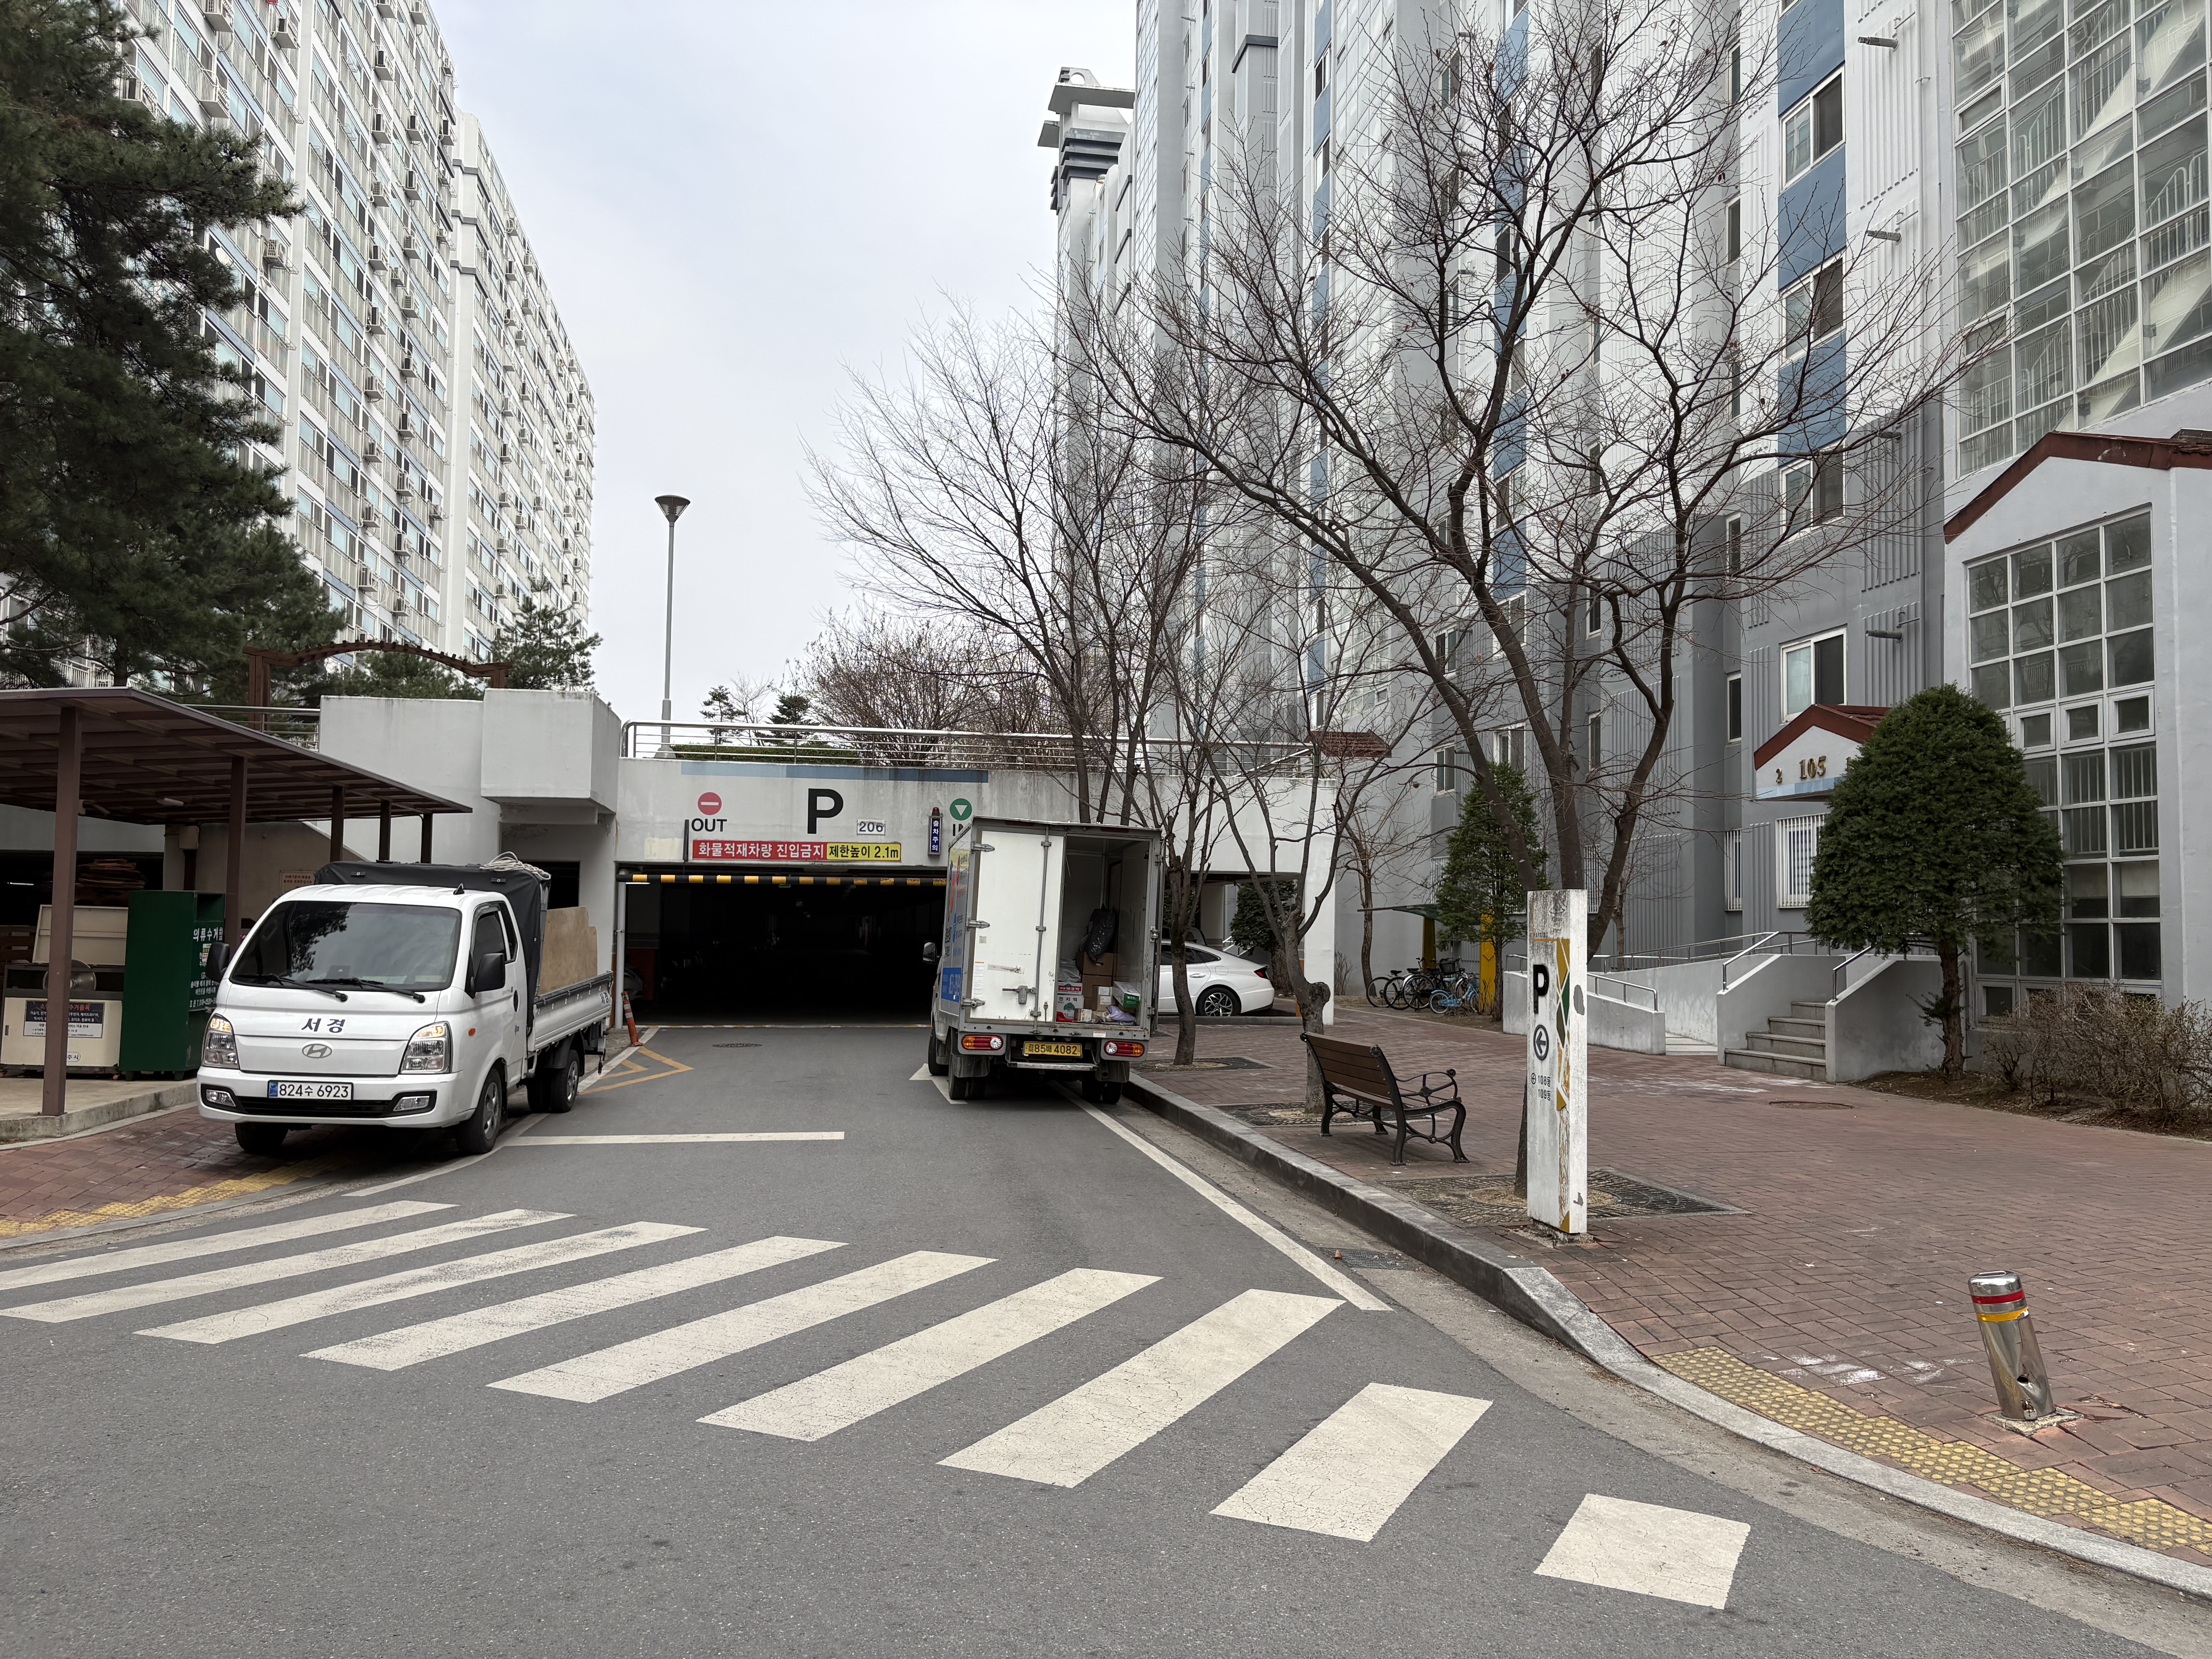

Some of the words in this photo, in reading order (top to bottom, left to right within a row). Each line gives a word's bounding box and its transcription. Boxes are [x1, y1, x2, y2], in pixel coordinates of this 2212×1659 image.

[1776, 768, 1783, 783] 2
[1799, 756, 1826, 779] 105
[807, 788, 843, 834] P
[691, 818, 727, 832] OUT
[859, 821, 883, 832] 206
[699, 842, 773, 858] 화물적재차량
[777, 843, 824, 859] 진입금지
[829, 845, 870, 859] 제한높이
[874, 846, 898, 858] 2.1m
[193, 927, 223, 942] 의류수거함
[1533, 964, 1549, 1014] P
[1054, 1045, 1077, 1054] 4082
[1538, 1075, 1551, 1087] 108동
[279, 1084, 313, 1097] 824수
[317, 1085, 349, 1098] 6923
[1538, 1089, 1551, 1101] 109동
